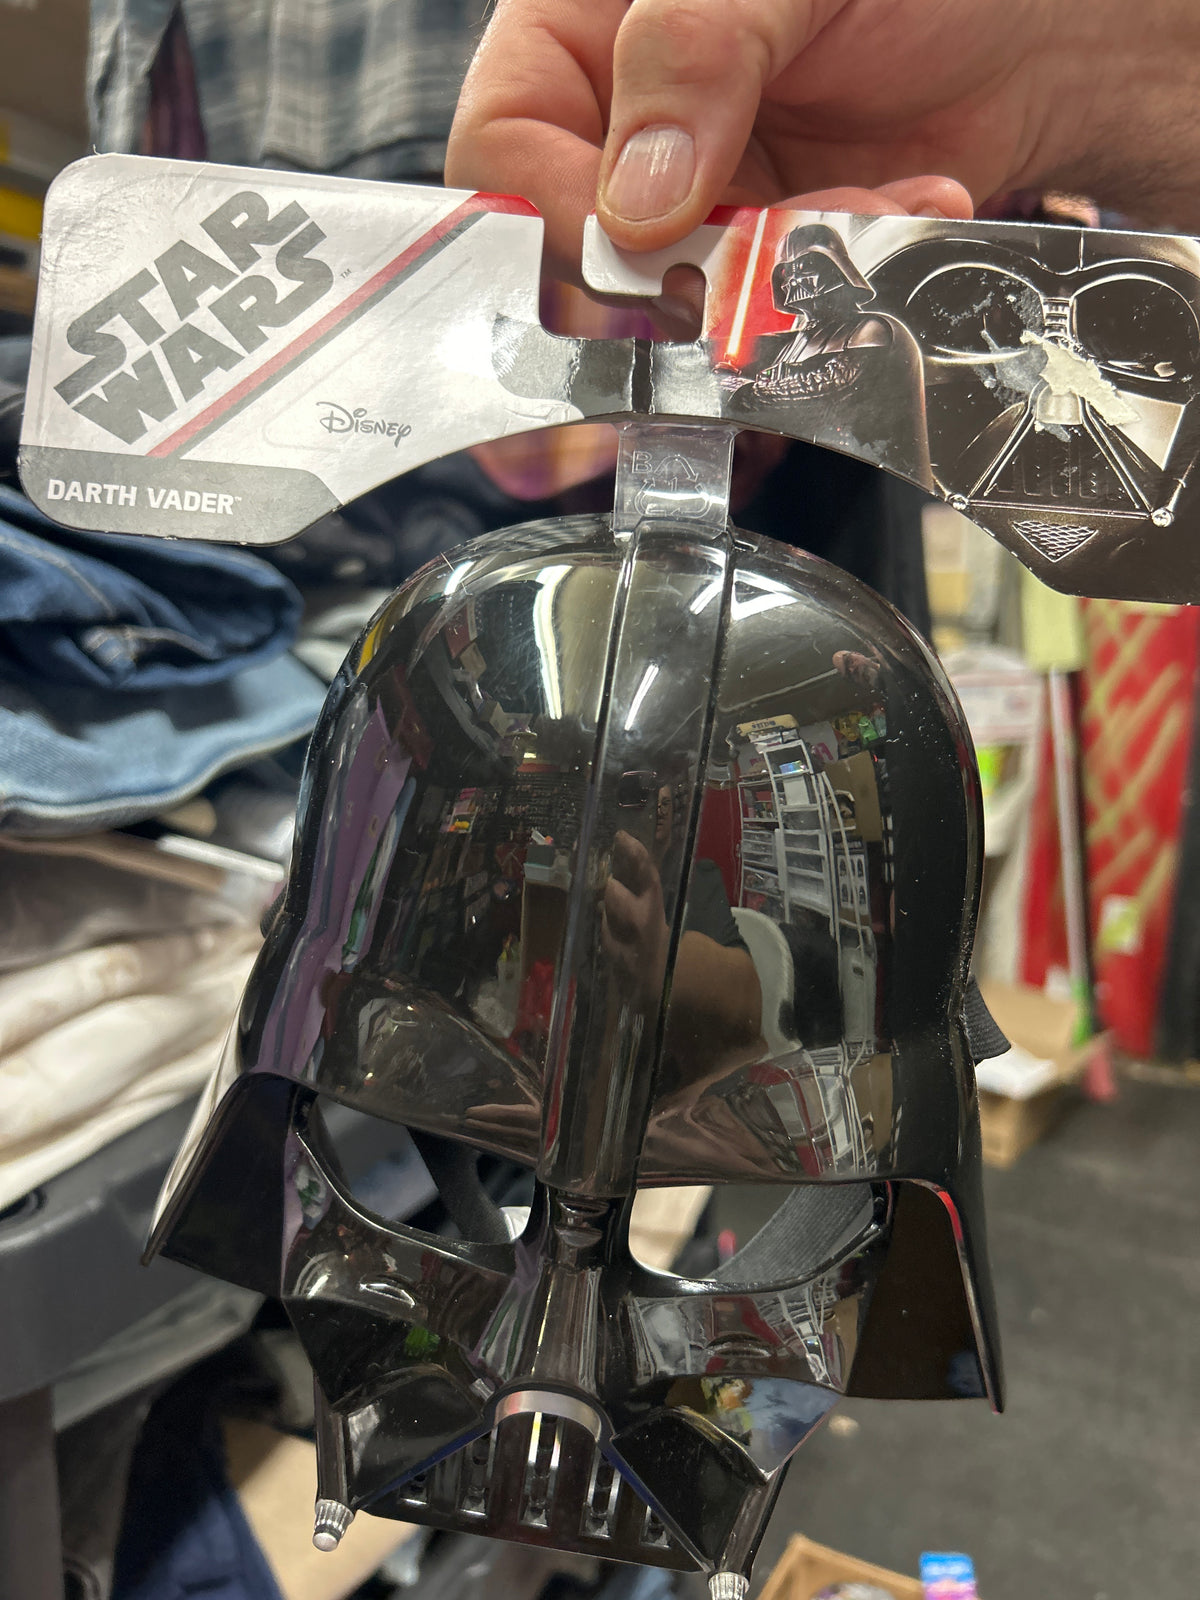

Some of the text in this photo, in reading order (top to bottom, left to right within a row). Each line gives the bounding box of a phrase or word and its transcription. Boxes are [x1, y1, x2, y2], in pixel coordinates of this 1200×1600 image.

[54, 190, 311, 405] STAR
[73, 220, 335, 445] WARS
[47, 479, 138, 507] DARTH
[147, 487, 234, 515] VADER
[631, 450, 653, 474] B
